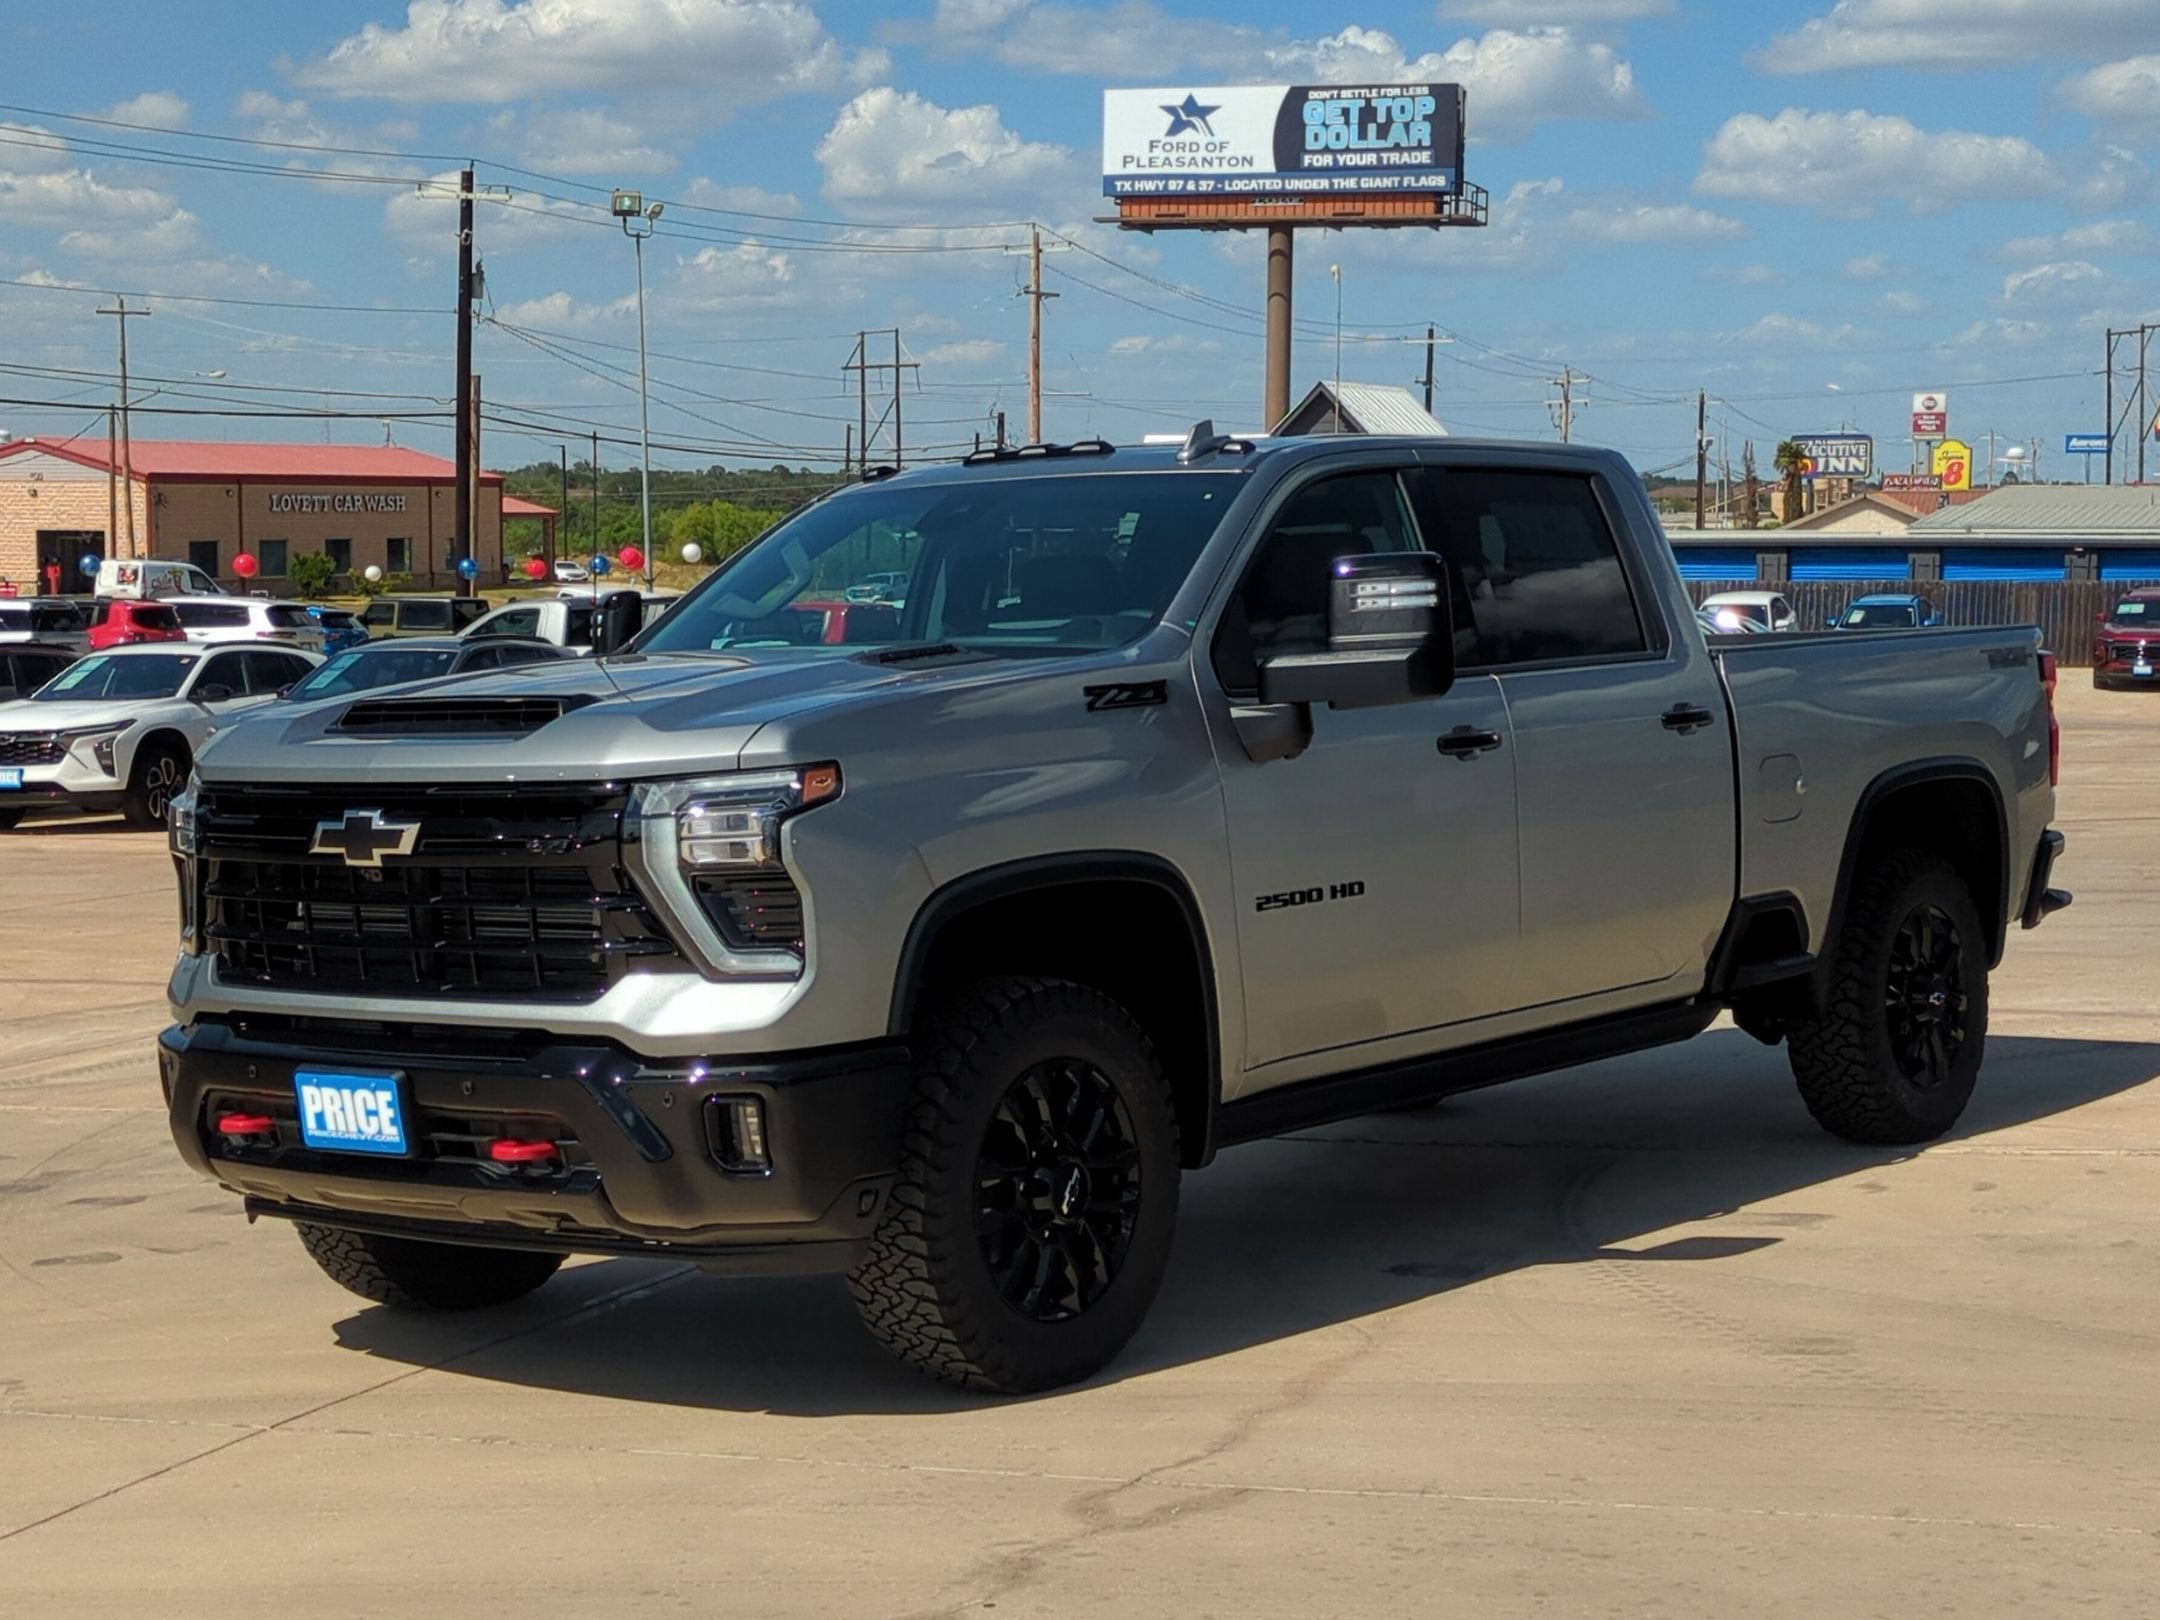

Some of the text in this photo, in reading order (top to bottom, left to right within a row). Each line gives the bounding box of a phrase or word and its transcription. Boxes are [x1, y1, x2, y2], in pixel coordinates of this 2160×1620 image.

[1308, 86, 1429, 100] DON'T SETTLE FOR LESS
[1303, 96, 1436, 125] GET TOP
[1305, 120, 1432, 150] DOLLAR
[1149, 139, 1230, 153] FORD OF
[1122, 155, 1254, 169] PLEASANTON
[1303, 151, 1432, 167] FOR YOUR TRADE
[1114, 181, 1132, 192] TX
[1134, 180, 1166, 191] HWY
[1167, 180, 1184, 191] 97
[1186, 180, 1196, 191] &
[1198, 180, 1215, 191] 37
[1225, 179, 1282, 191] LOCATED
[1284, 178, 1329, 190] UNDER
[1332, 178, 1358, 189] THE
[1360, 177, 1400, 188] GIANT
[1403, 175, 1446, 187] FLAGS
[1798, 441, 1866, 456] XECUTIVE
[1817, 457, 1867, 472] INN
[1942, 461, 1965, 486] 8
[270, 494, 406, 512] LOVETT CAR WASH
[1256, 881, 1365, 912] 2500 HD
[301, 1085, 399, 1136] PRICE
